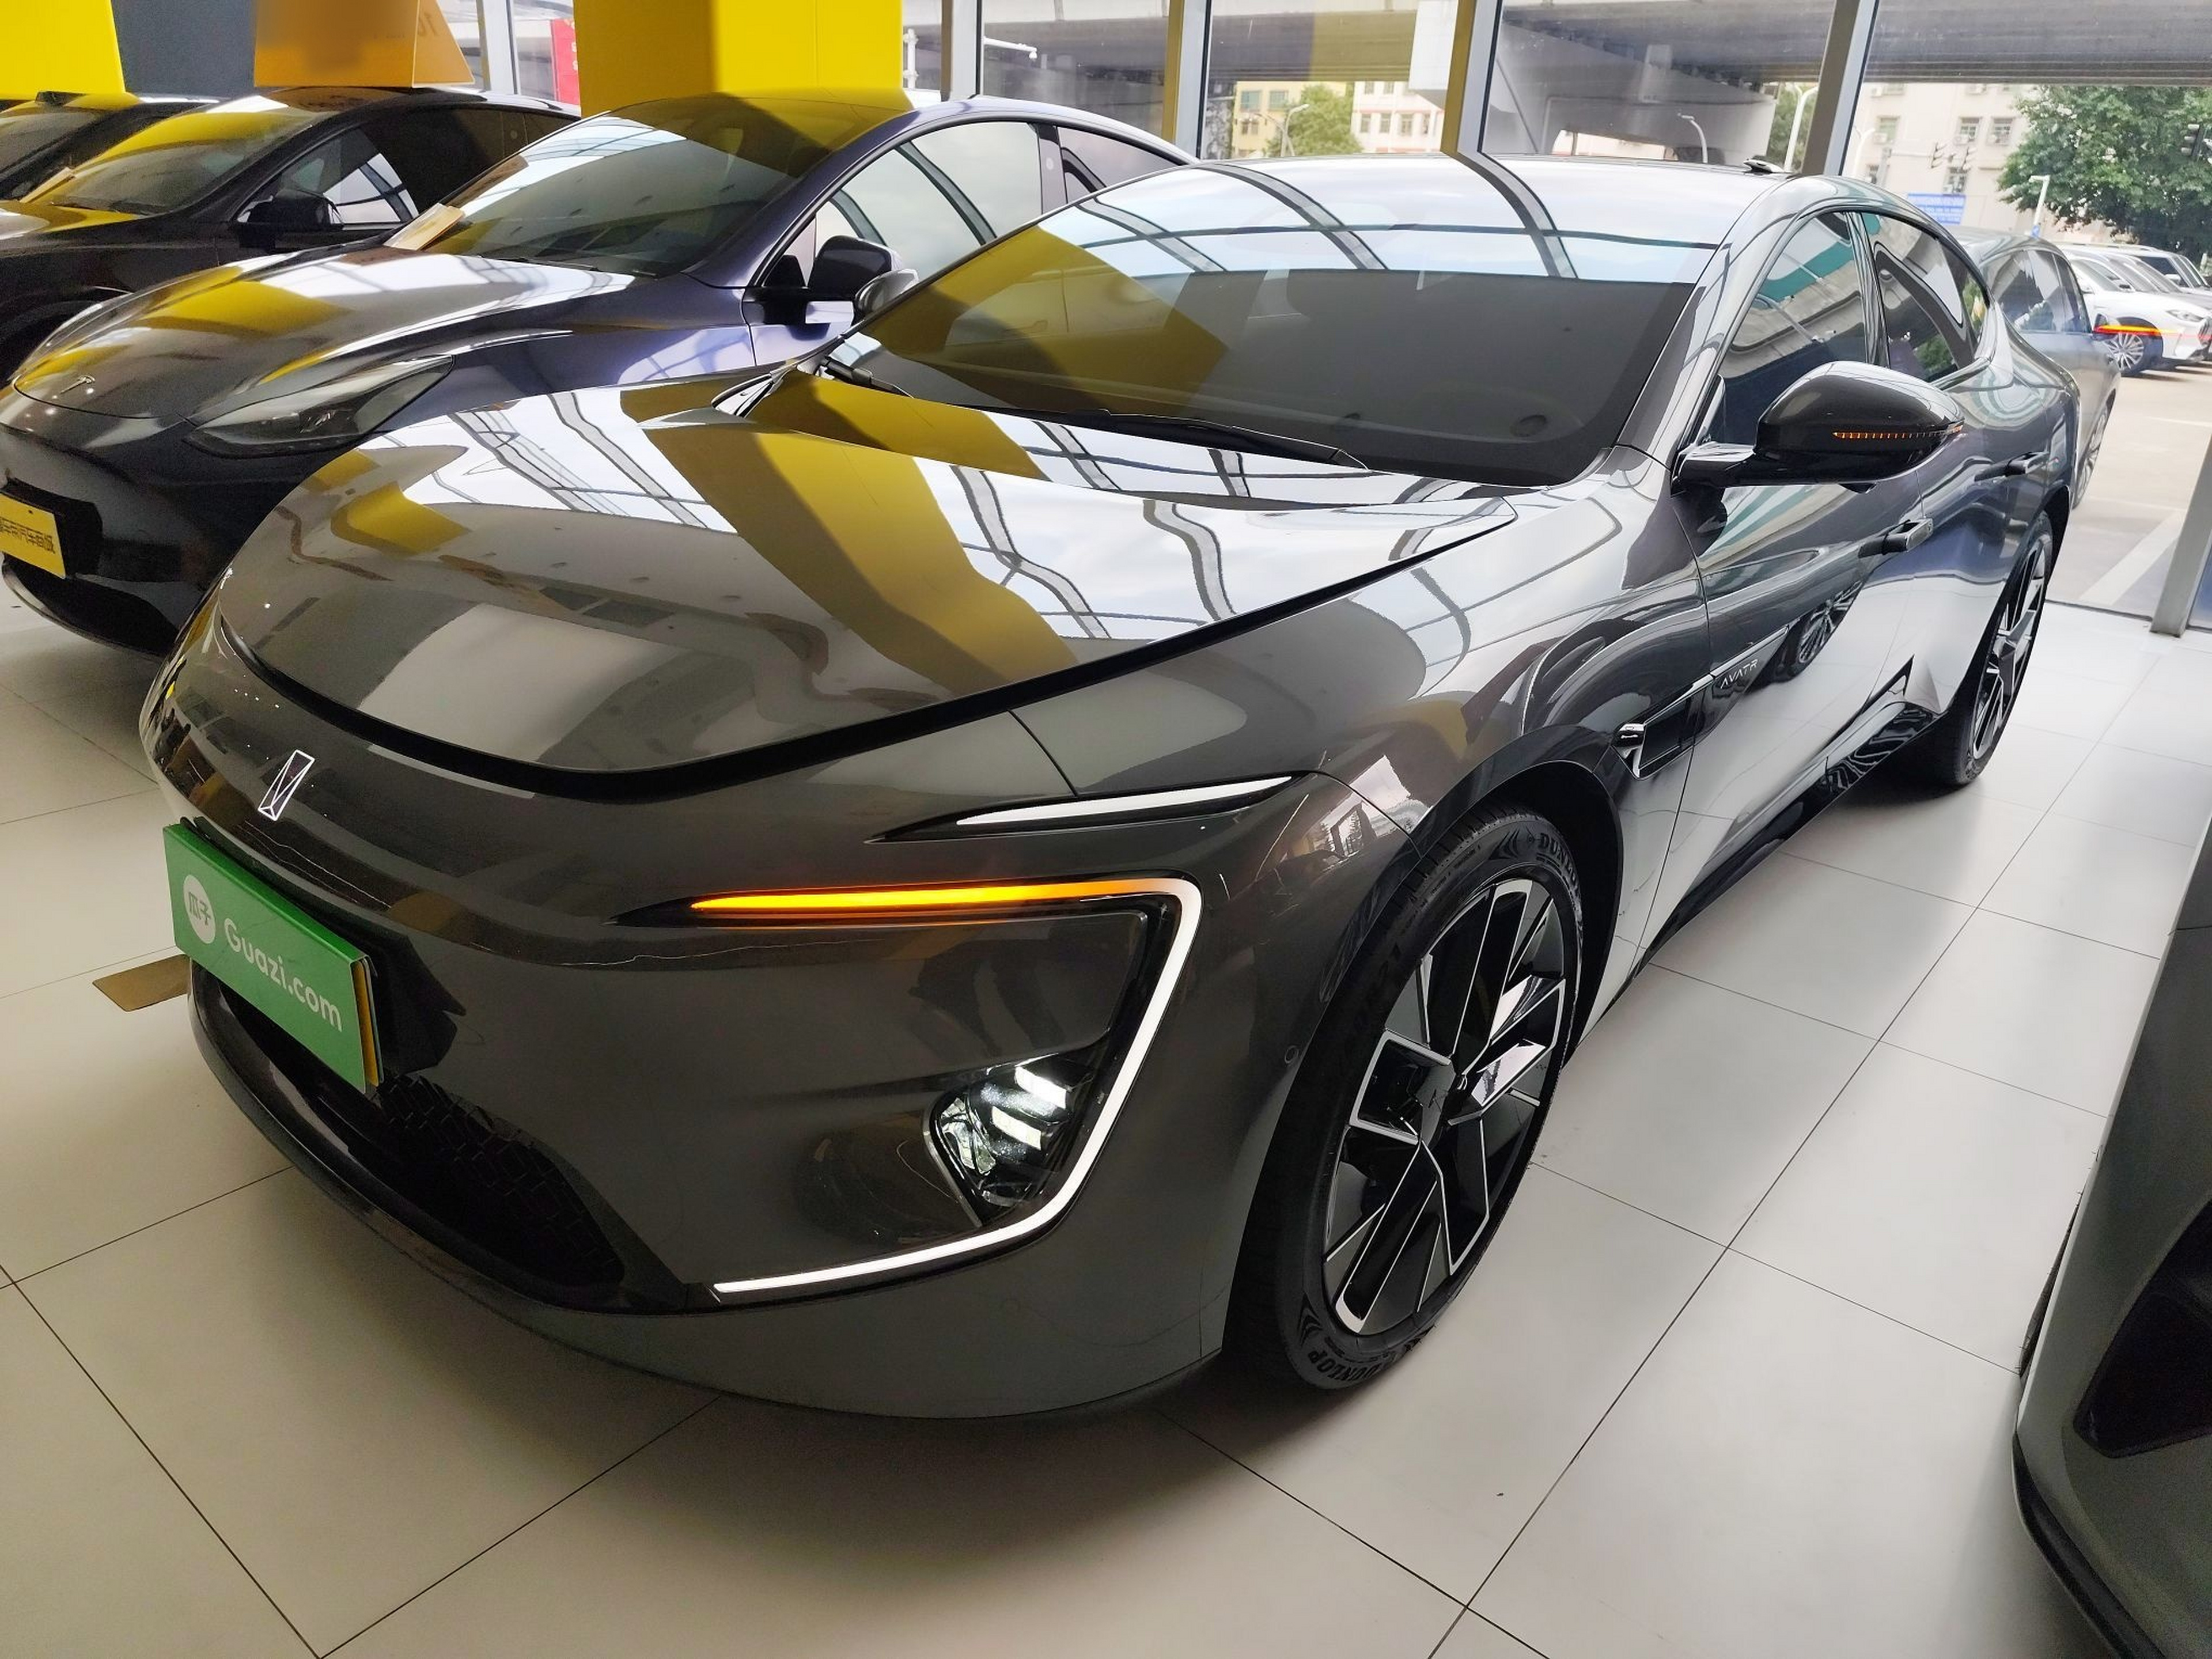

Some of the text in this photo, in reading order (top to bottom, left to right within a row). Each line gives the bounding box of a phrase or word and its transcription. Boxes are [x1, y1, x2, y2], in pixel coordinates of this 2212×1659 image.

[1720, 659, 1758, 689] AVATR
[188, 891, 211, 926] 瓜子
[224, 918, 343, 1032] Guazi.com
[1308, 1350, 1383, 1381] DUNLOP
